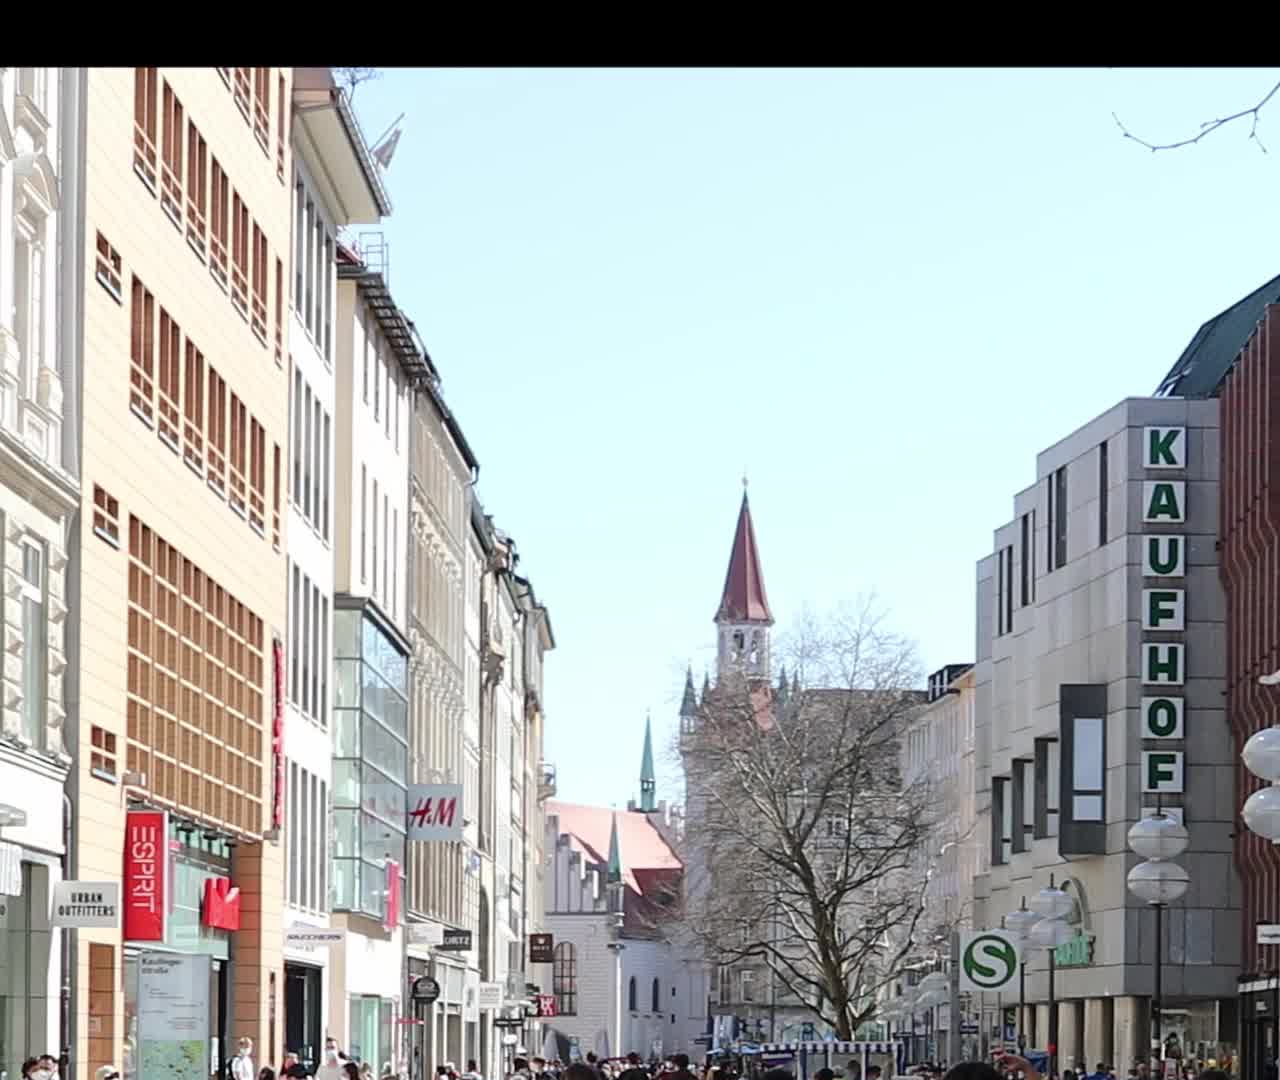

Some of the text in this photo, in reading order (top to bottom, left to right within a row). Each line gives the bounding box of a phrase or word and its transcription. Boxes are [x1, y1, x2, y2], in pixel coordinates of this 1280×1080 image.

[1146, 429, 1181, 790] KAUFHOF
[409, 797, 457, 828] H&M
[132, 826, 156, 913] ESPRIT
[58, 905, 115, 917] OUTFITTERS
[71, 892, 103, 904] URBAN
[969, 937, 1011, 986] S
